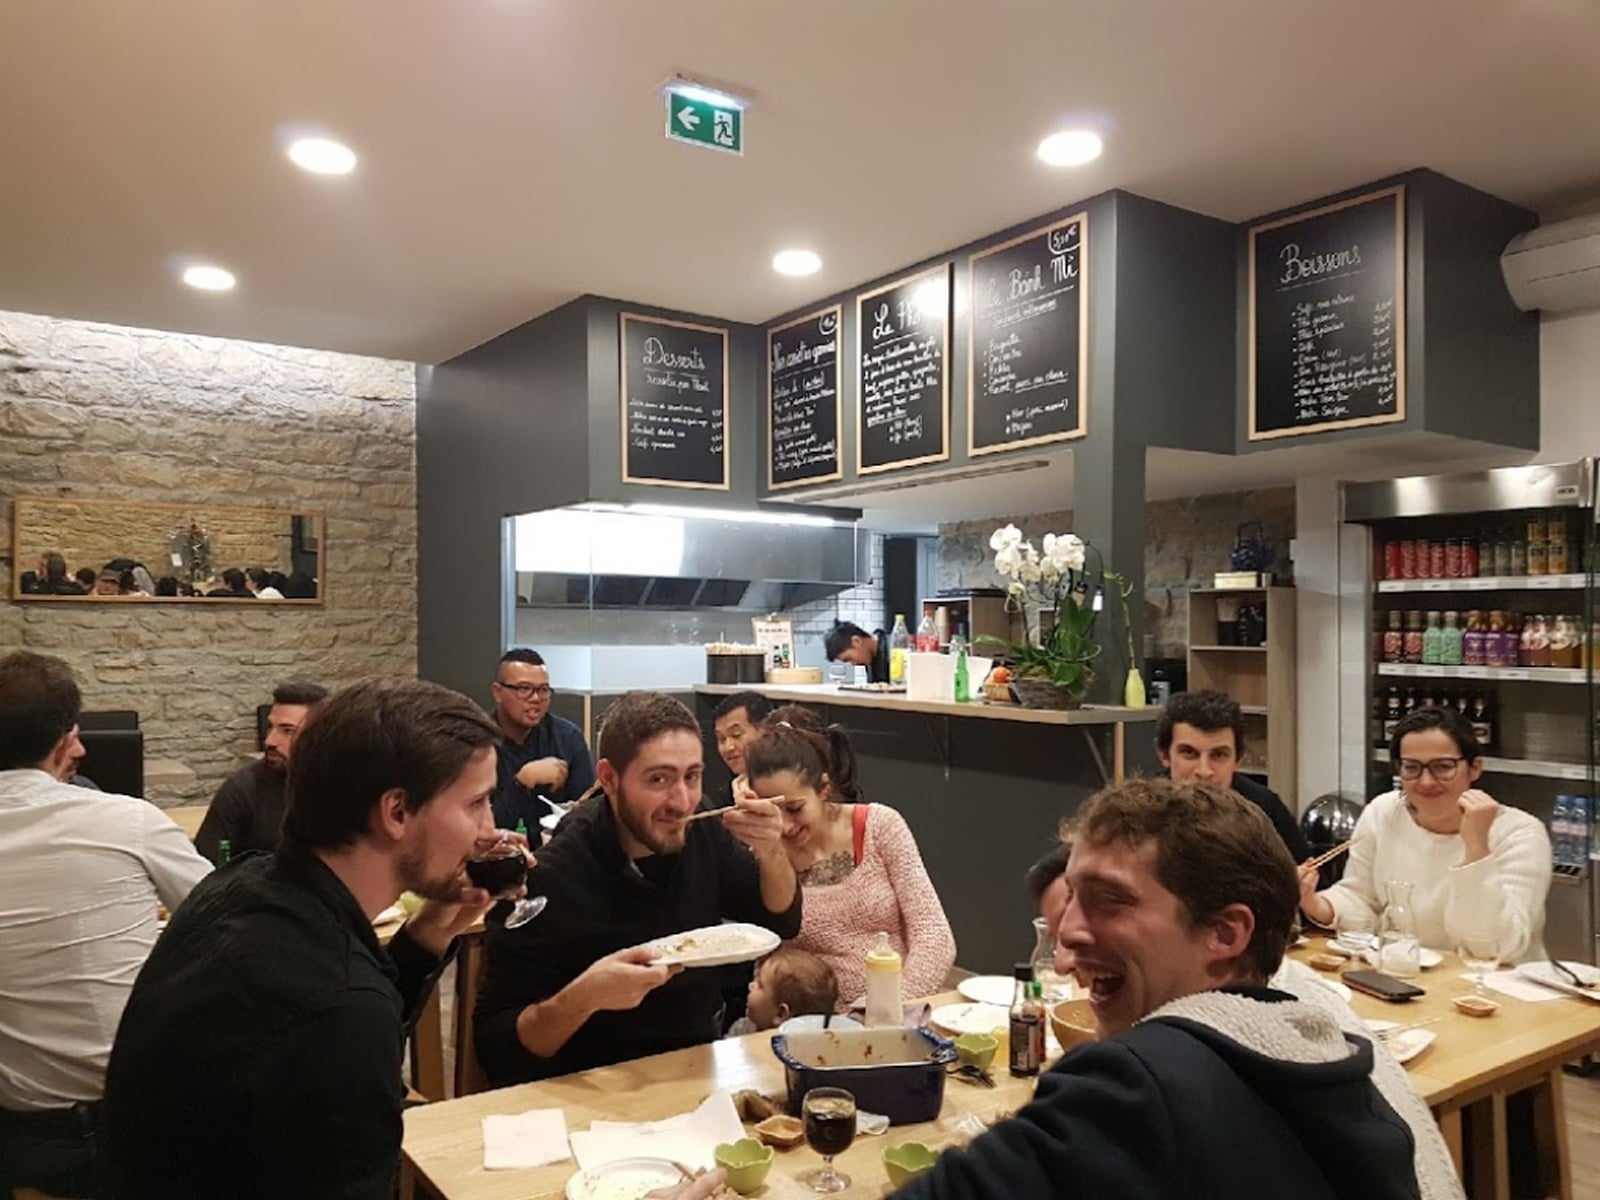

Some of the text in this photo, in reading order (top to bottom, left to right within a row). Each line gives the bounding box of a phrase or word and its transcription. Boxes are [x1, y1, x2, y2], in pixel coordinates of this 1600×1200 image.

[1280, 243, 1362, 283] Boissons
[872, 303, 895, 340] Le
[643, 336, 706, 371] Desserts
